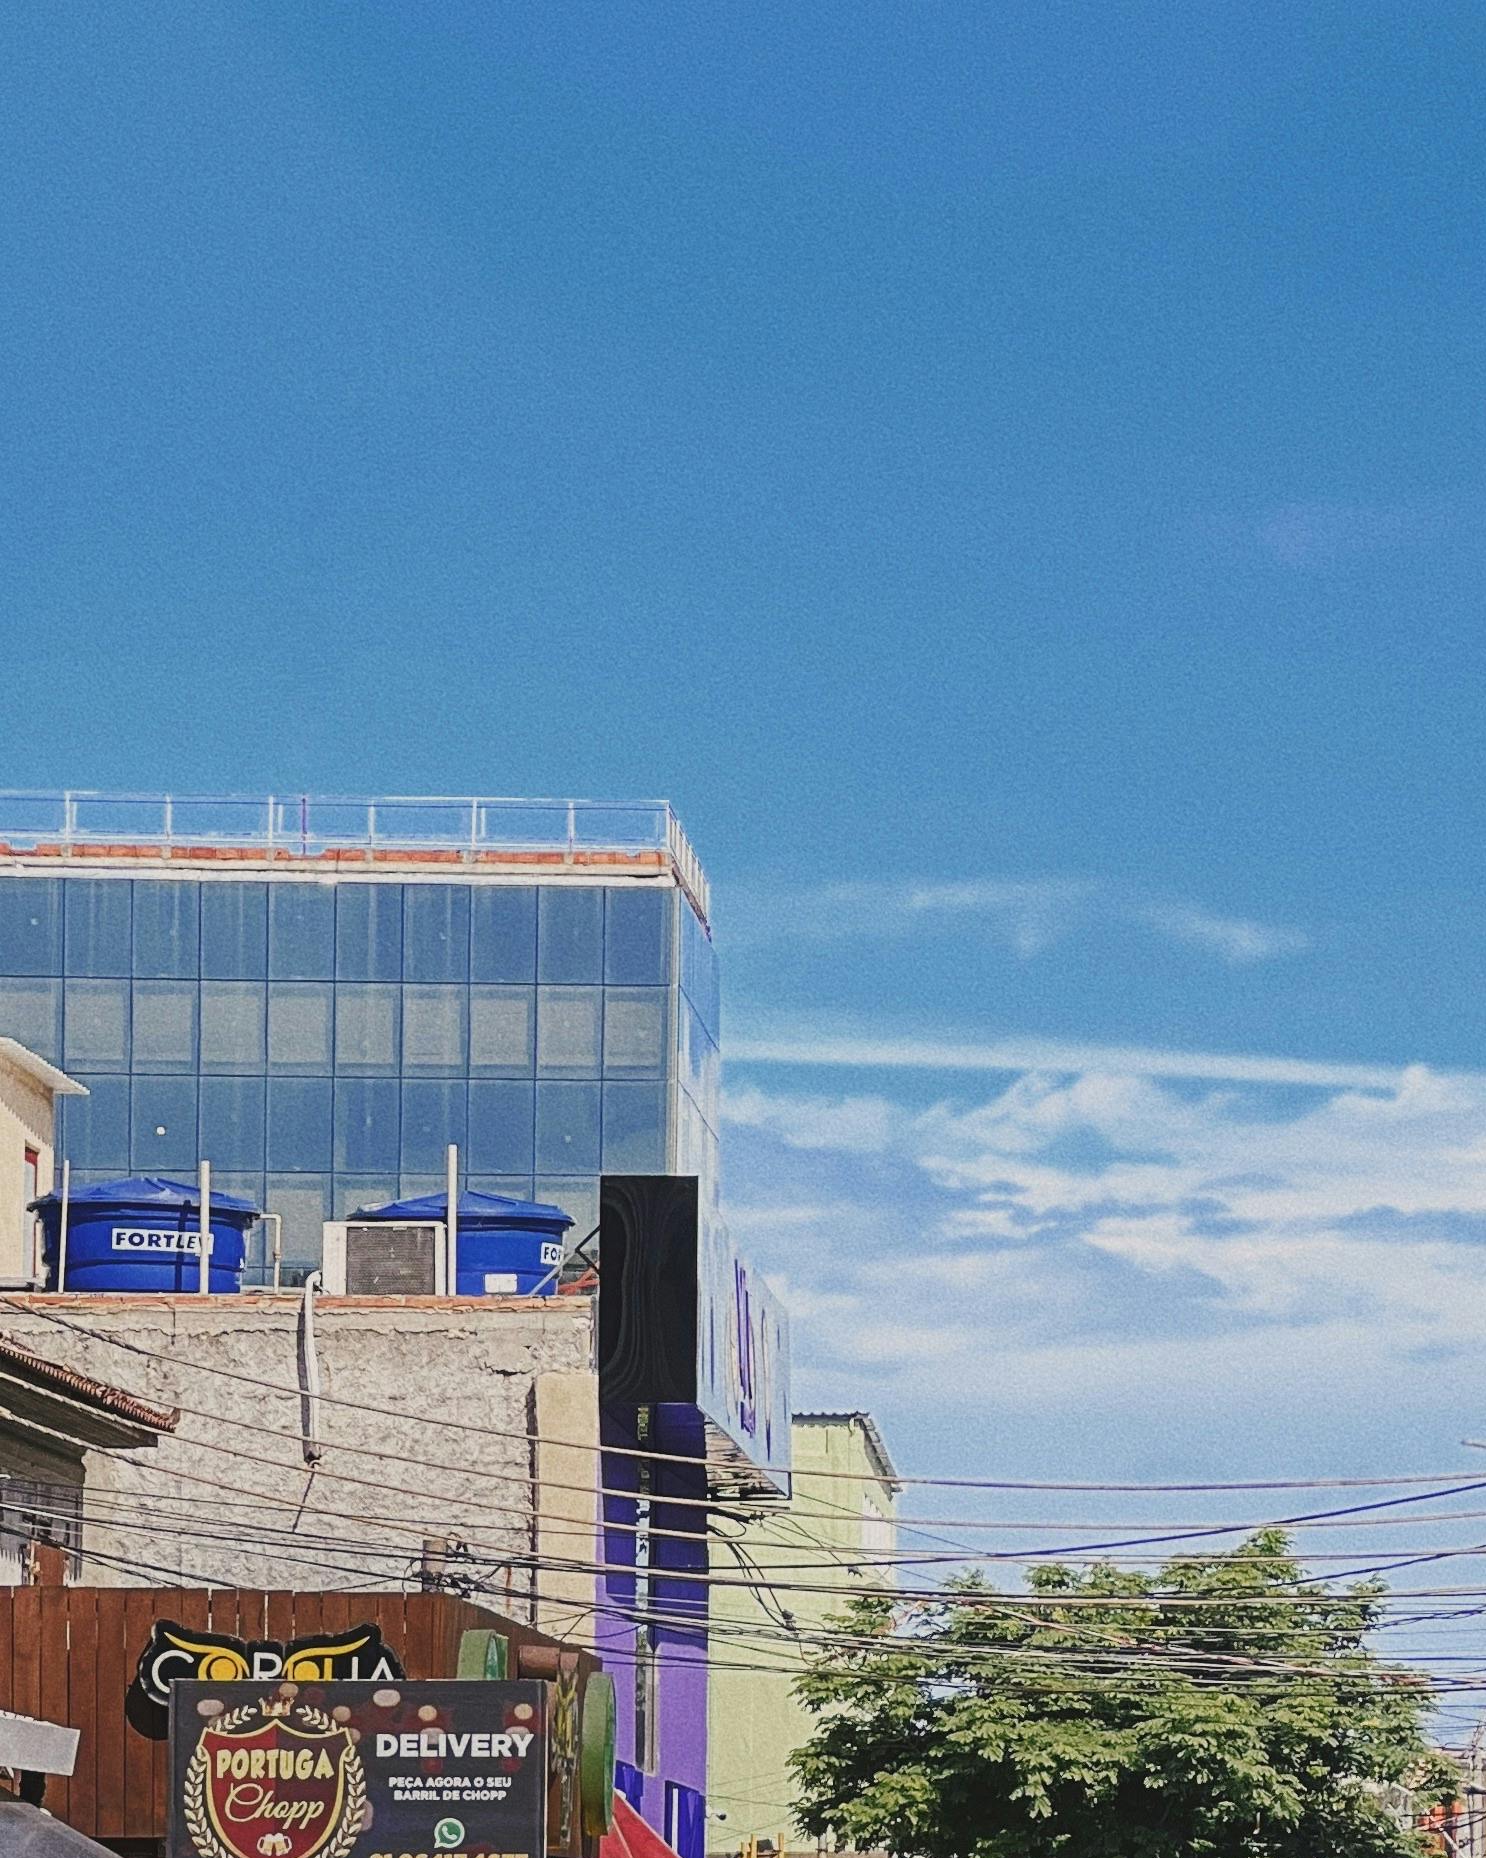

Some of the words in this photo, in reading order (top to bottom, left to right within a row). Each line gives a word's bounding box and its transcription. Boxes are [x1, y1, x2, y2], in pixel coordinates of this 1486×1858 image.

[115, 1232, 202, 1249] FORTLE
[376, 1733, 534, 1758] DELIVERY
[216, 1748, 335, 1780] PORTUGA
[388, 1776, 424, 1789] PEÇA
[426, 1776, 472, 1788] AGORA
[474, 1776, 485, 1788] O
[487, 1776, 512, 1788] SEU
[394, 1789, 441, 1801] BARRIL
[442, 1789, 461, 1801] DE
[463, 1789, 507, 1801] CHOPP
[224, 1783, 326, 1830] Chopp
